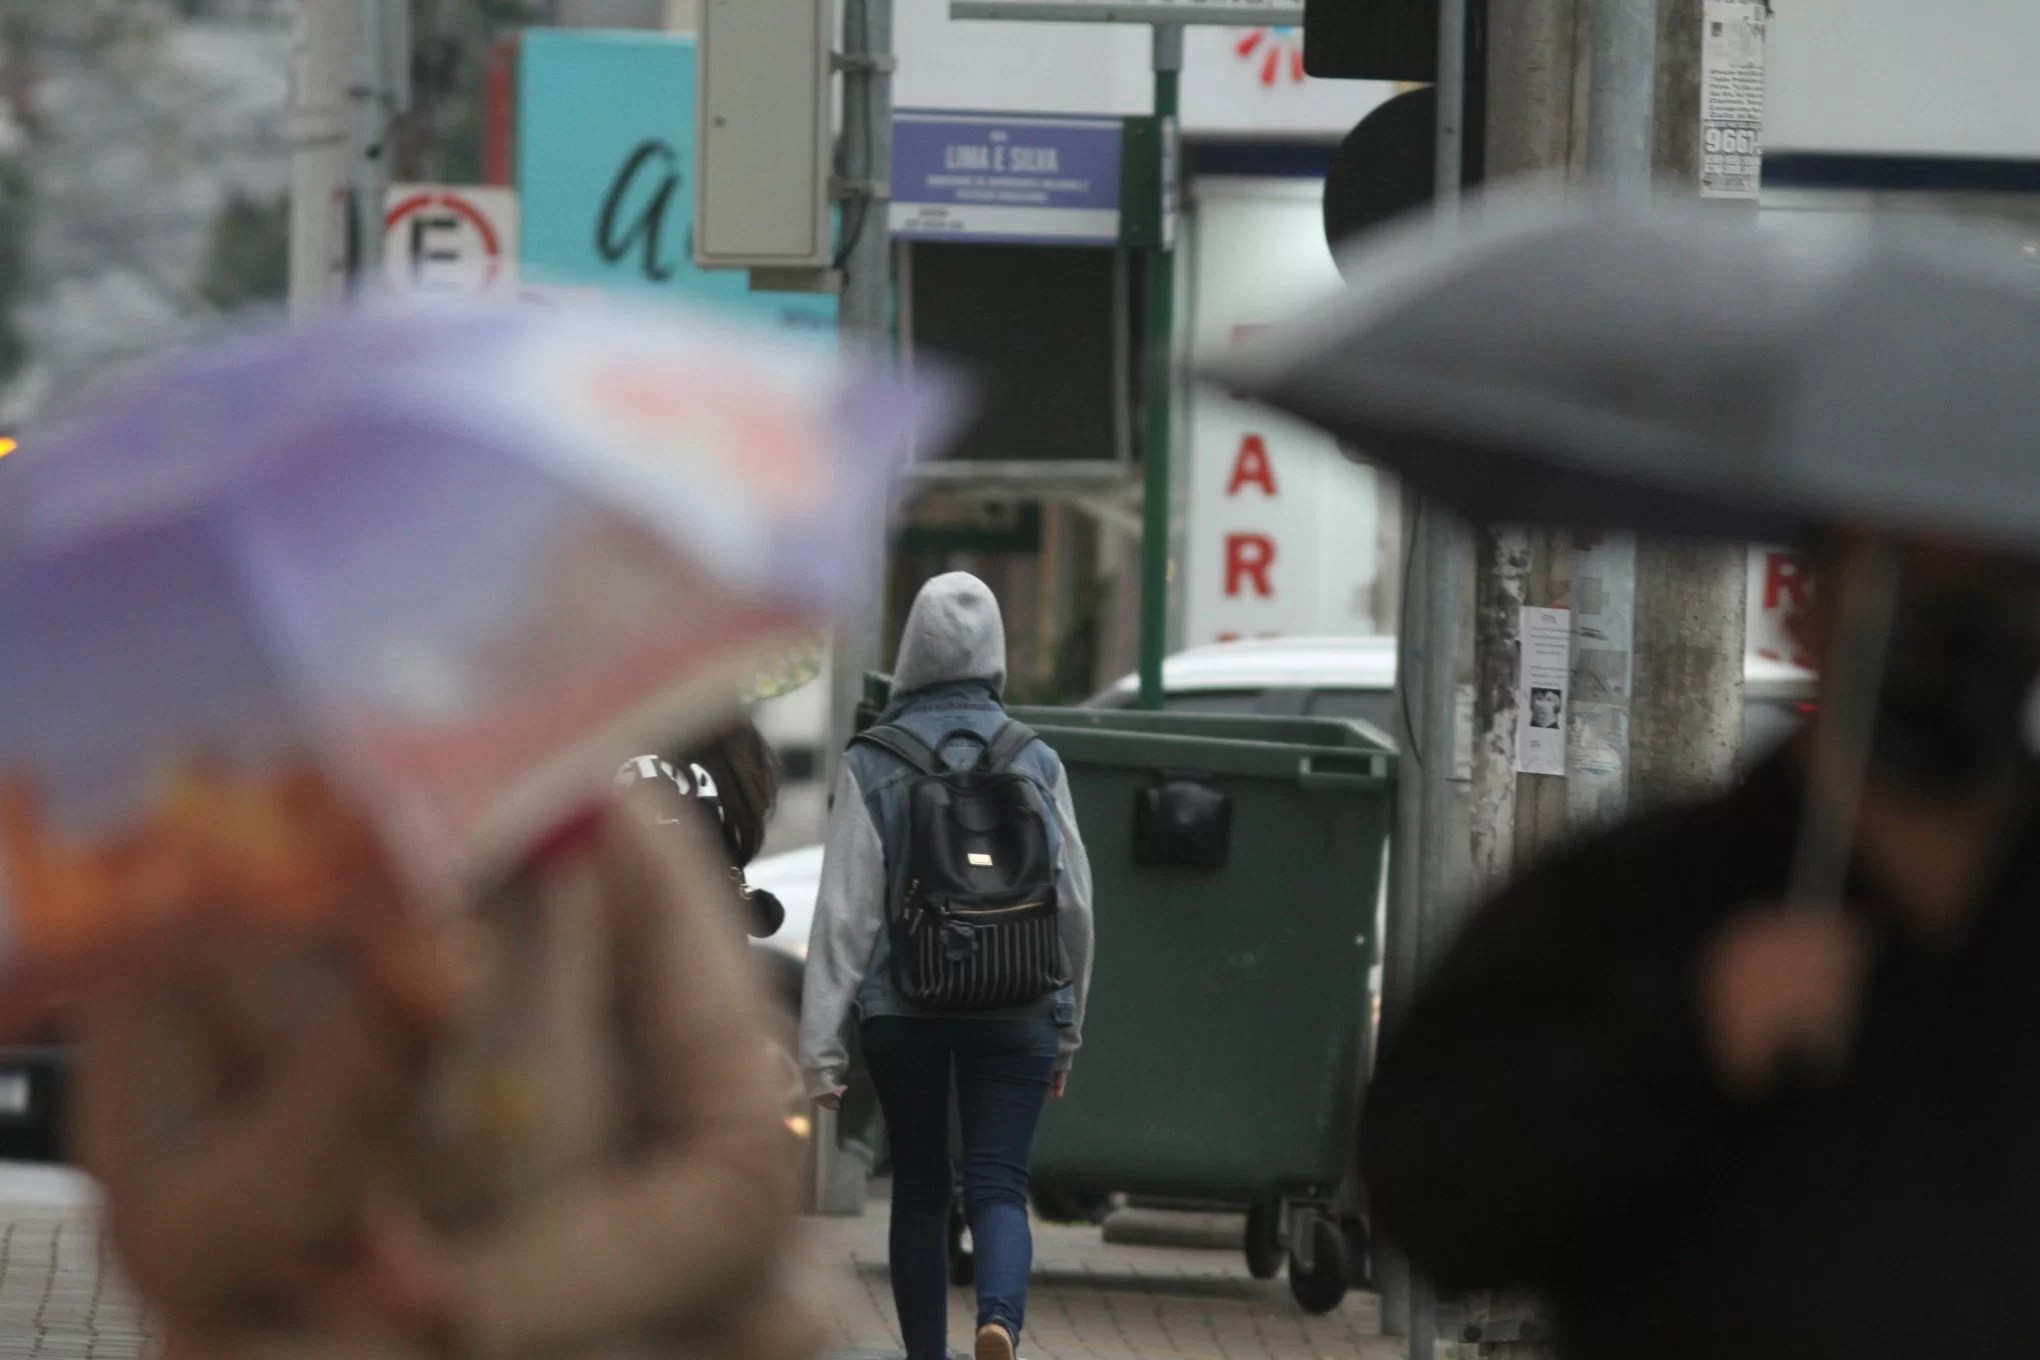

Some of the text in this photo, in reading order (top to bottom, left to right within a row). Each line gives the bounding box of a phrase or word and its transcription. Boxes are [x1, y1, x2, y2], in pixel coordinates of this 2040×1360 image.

[945, 145, 989, 171] LIMA
[1009, 148, 1059, 173] SILVA
[410, 217, 461, 286] E
